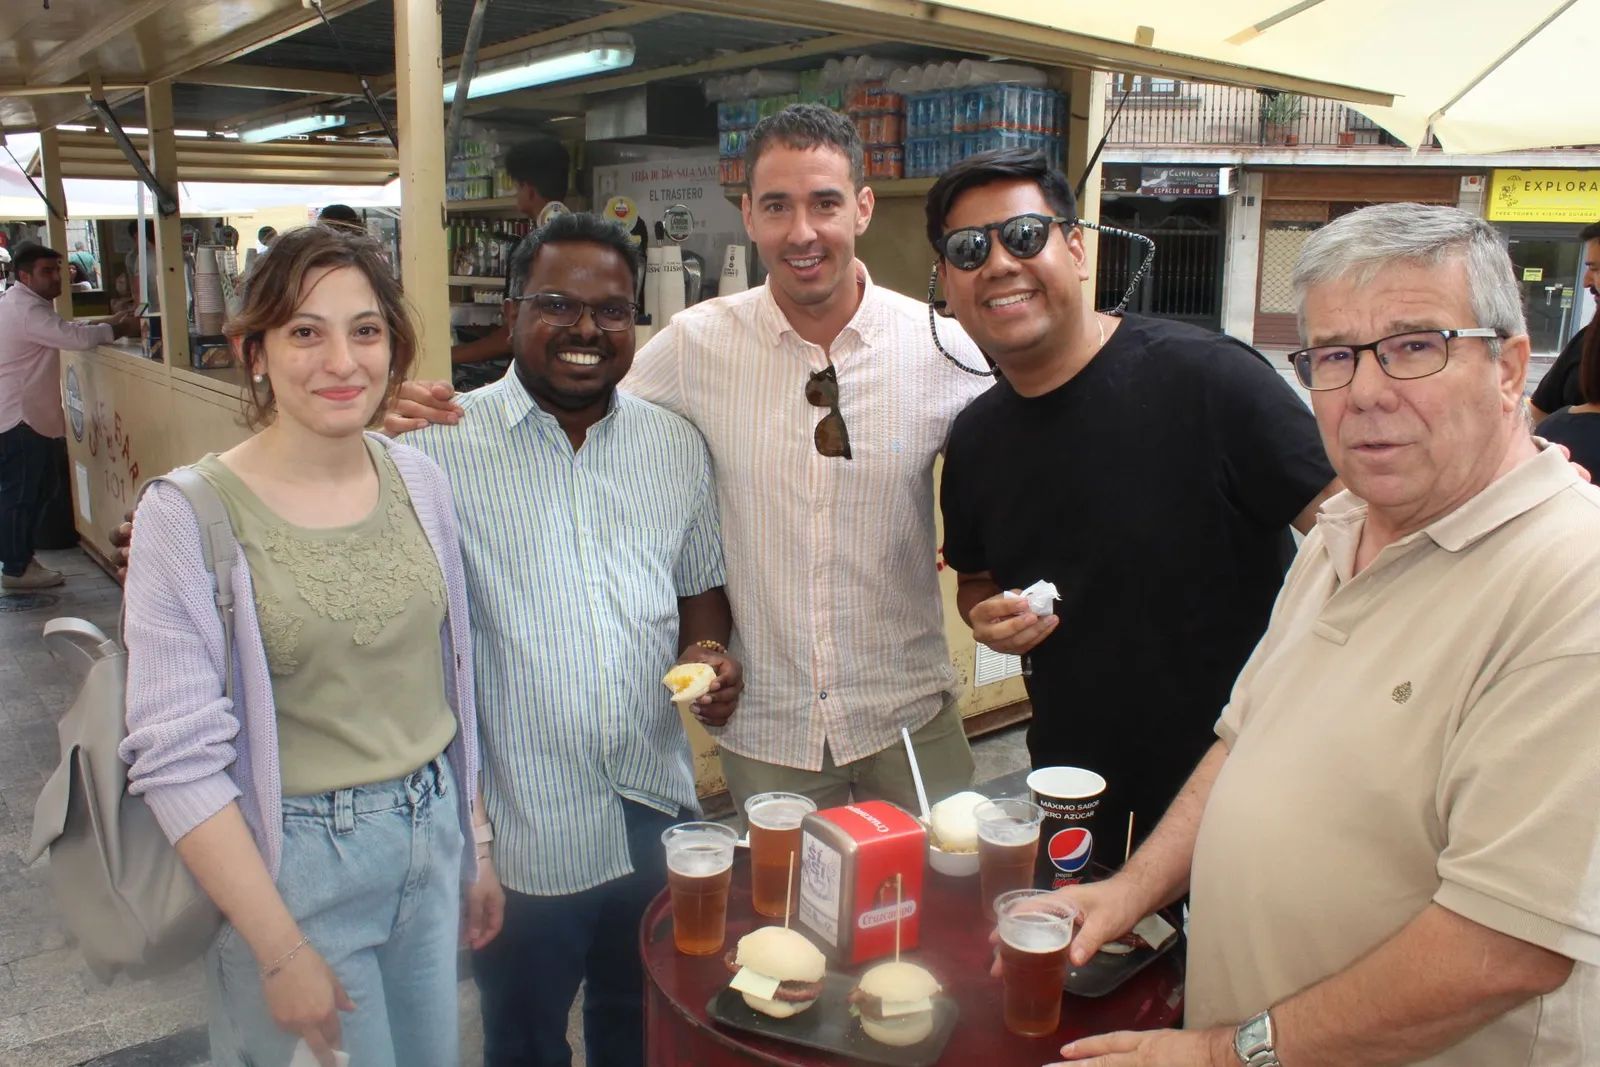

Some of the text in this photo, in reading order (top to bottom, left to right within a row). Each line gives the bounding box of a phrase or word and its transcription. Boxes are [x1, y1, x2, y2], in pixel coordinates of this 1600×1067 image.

[1153, 187, 1213, 195] ESPACIO DE SALUD
[1524, 181, 1599, 192] EXPLORA
[650, 187, 703, 201] EL TRASTERO
[1077, 799, 1100, 810] SABOR
